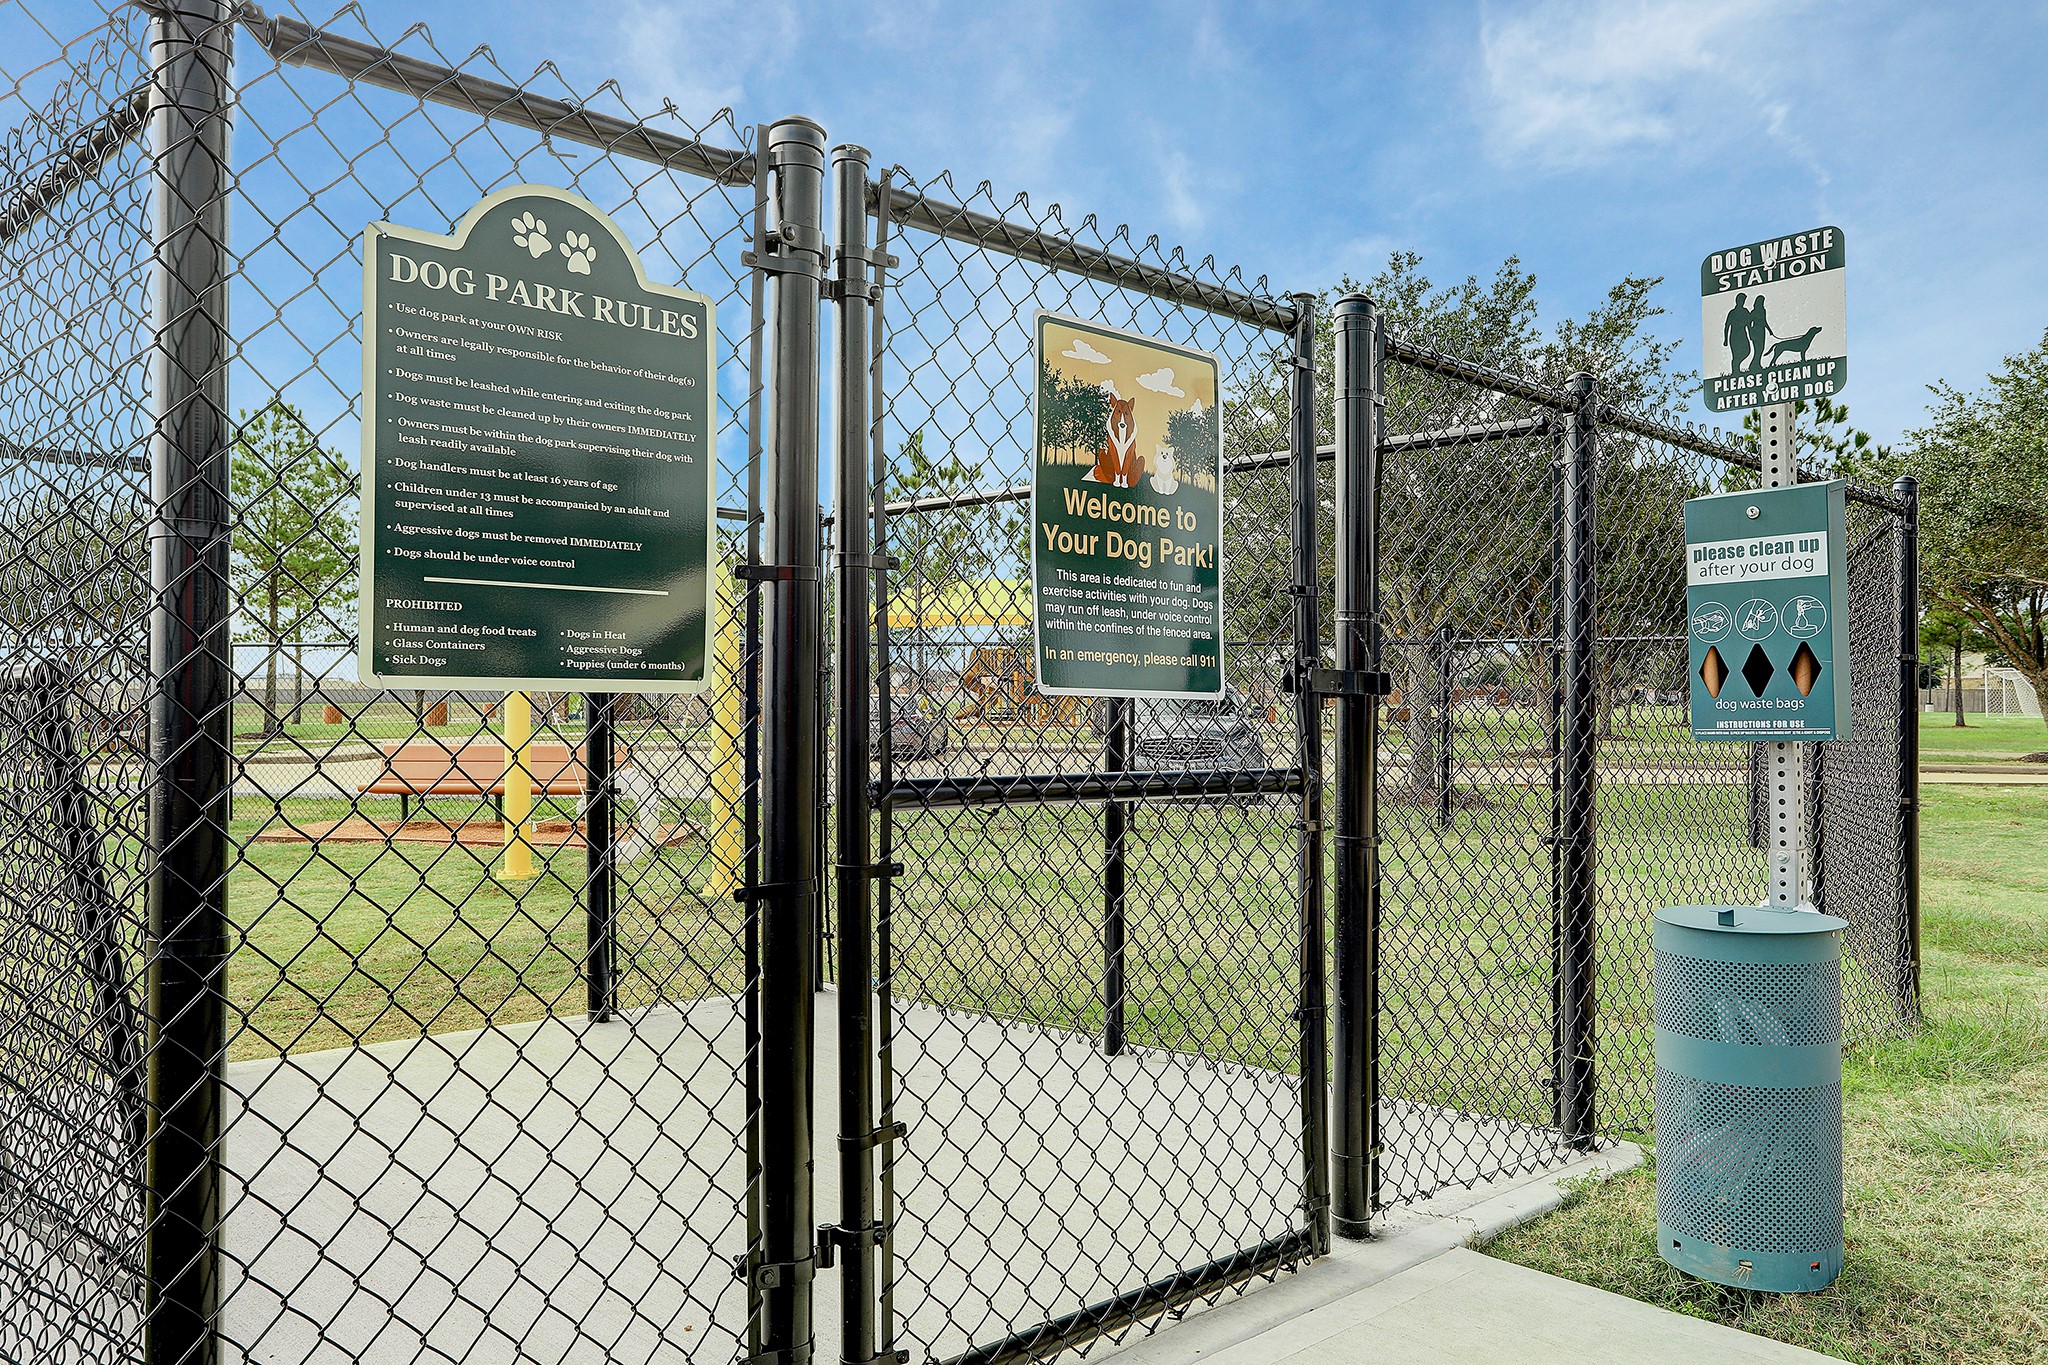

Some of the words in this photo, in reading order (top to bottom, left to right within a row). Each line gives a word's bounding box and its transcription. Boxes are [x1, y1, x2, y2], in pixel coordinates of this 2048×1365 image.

[1711, 248, 1752, 274] DOG
[1760, 228, 1833, 262] WASTE
[1718, 254, 1826, 291] STATION
[389, 253, 476, 295] DOG
[485, 273, 585, 318] PARK
[592, 295, 697, 338] RULES
[396, 302, 416, 314] Use
[419, 306, 439, 321] dog
[441, 313, 466, 324] park
[468, 318, 479, 326] at
[481, 320, 506, 330] your
[507, 323, 534, 335] OWN
[536, 328, 563, 341] RISK
[395, 327, 438, 342] Owners
[440, 337, 458, 346] are
[460, 337, 494, 354] legally
[496, 346, 554, 362] responsible
[556, 354, 572, 365] for
[573, 358, 589, 368] the
[590, 360, 632, 375] behavior
[633, 368, 644, 377] of
[644, 370, 666, 381] their
[667, 373, 695, 387] dog(s)
[396, 345, 407, 353] at
[410, 345, 423, 356] all
[426, 348, 456, 361] times
[1714, 373, 1762, 393] PLEASE
[1767, 366, 1811, 383] CLEAN
[1816, 361, 1836, 376] UP
[1716, 392, 1757, 410] AFTER
[1763, 386, 1799, 402] YOUR
[1804, 380, 1834, 397] DOG
[395, 392, 418, 406] Dog
[419, 398, 451, 408] waste
[453, 402, 480, 412] must
[482, 404, 494, 414] be
[496, 406, 536, 420] cleaned
[537, 414, 550, 424] up
[552, 414, 564, 426] by
[566, 416, 590, 427] their
[591, 422, 626, 432] owners
[628, 425, 696, 442] IMMEDIATELY
[398, 432, 427, 445] leash
[430, 439, 468, 452] readily
[470, 444, 516, 456] available
[395, 457, 417, 470] Dog
[419, 459, 467, 474] handlers
[469, 468, 496, 477] must
[498, 468, 510, 479] be
[512, 472, 522, 480] at
[524, 471, 548, 483] least
[550, 475, 561, 484] 16
[562, 478, 588, 487] years
[590, 480, 601, 488] of
[602, 483, 618, 492] age
[394, 481, 442, 495] Children
[445, 488, 478, 498] under
[480, 492, 491, 501] 13
[493, 494, 519, 503] must
[521, 494, 533, 504] be
[535, 498, 599, 510] accompanied
[600, 502, 612, 513] by
[627, 506, 651, 516] adult
[652, 509, 670, 517] and
[394, 500, 454, 512] supervised
[456, 505, 467, 513] at
[469, 505, 482, 514] all
[485, 506, 513, 517] times
[1063, 487, 1170, 528] Welcome
[1176, 505, 1196, 531] to
[393, 522, 452, 536] Aggressive
[454, 527, 480, 540] dogs
[482, 532, 508, 540] must
[510, 531, 522, 542] be
[524, 535, 568, 545] removed
[570, 537, 642, 551] IMMEDIATELY
[1042, 522, 1098, 555] Your
[1106, 530, 1151, 568] Dog
[1160, 537, 1213, 568] Park!
[394, 546, 421, 559] Dogs
[423, 549, 461, 560] should
[462, 551, 476, 561] be
[478, 553, 510, 563] under
[511, 556, 537, 566] voice
[539, 559, 575, 568] control
[1693, 546, 1745, 563] please
[1749, 541, 1794, 557] clean
[1799, 538, 1820, 554] up
[1699, 562, 1735, 578] after
[1740, 560, 1776, 578] your
[1781, 556, 1814, 572] dog
[1056, 568, 1077, 581] This
[1080, 573, 1100, 583] area
[1102, 575, 1111, 584] is
[1113, 574, 1156, 588] dedicated
[1158, 579, 1168, 590] to
[1169, 580, 1183, 591] fun
[1185, 583, 1201, 593] and
[386, 598, 462, 611] PROHIBITED
[1042, 586, 1083, 598] exercise
[1085, 589, 1126, 602] activities
[1128, 593, 1147, 604] with
[1150, 596, 1170, 607] your
[1171, 596, 1190, 610] dog.
[1192, 597, 1213, 611] Dogs
[1045, 603, 1065, 616] may
[1068, 605, 1084, 614] run
[1086, 604, 1099, 615] off
[1101, 605, 1128, 620] leash,
[1131, 609, 1156, 620] under
[1158, 611, 1182, 622] voice
[1183, 614, 1212, 624] control
[393, 622, 434, 632] Human
[437, 624, 458, 633] and
[460, 624, 480, 636] dog
[481, 625, 505, 635] food
[507, 627, 536, 636] treats
[566, 629, 590, 640] Dogs
[592, 630, 602, 638] in
[604, 631, 626, 639] Heat
[1045, 618, 1074, 630] within
[1076, 620, 1092, 631] the
[1094, 622, 1133, 634] confines
[1135, 624, 1144, 635] of
[1146, 625, 1161, 636] the
[1162, 626, 1191, 638] fenced
[1192, 630, 1212, 639] area.
[392, 638, 423, 648] Glass
[426, 639, 485, 650] Containers
[566, 644, 617, 655] Aggressive
[619, 645, 642, 656] Dogs
[1045, 645, 1056, 659] In
[1060, 649, 1074, 660] an
[1077, 650, 1140, 666] emergency,
[1144, 651, 1178, 667] please
[1180, 654, 1197, 666] call
[1200, 654, 1215, 667] 911
[392, 654, 416, 664] Sick
[419, 655, 446, 667] Dogs
[566, 658, 605, 670] Puppies
[606, 660, 639, 670] (under
[640, 660, 646, 669] 6
[648, 661, 685, 671] months)
[1715, 698, 1738, 710] dog
[1740, 699, 1773, 710] waste
[1776, 698, 1805, 710] bags
[1716, 720, 1770, 728] INSTRUCTIONS
[1773, 720, 1788, 728] FOR
[1790, 720, 1804, 728] USE
